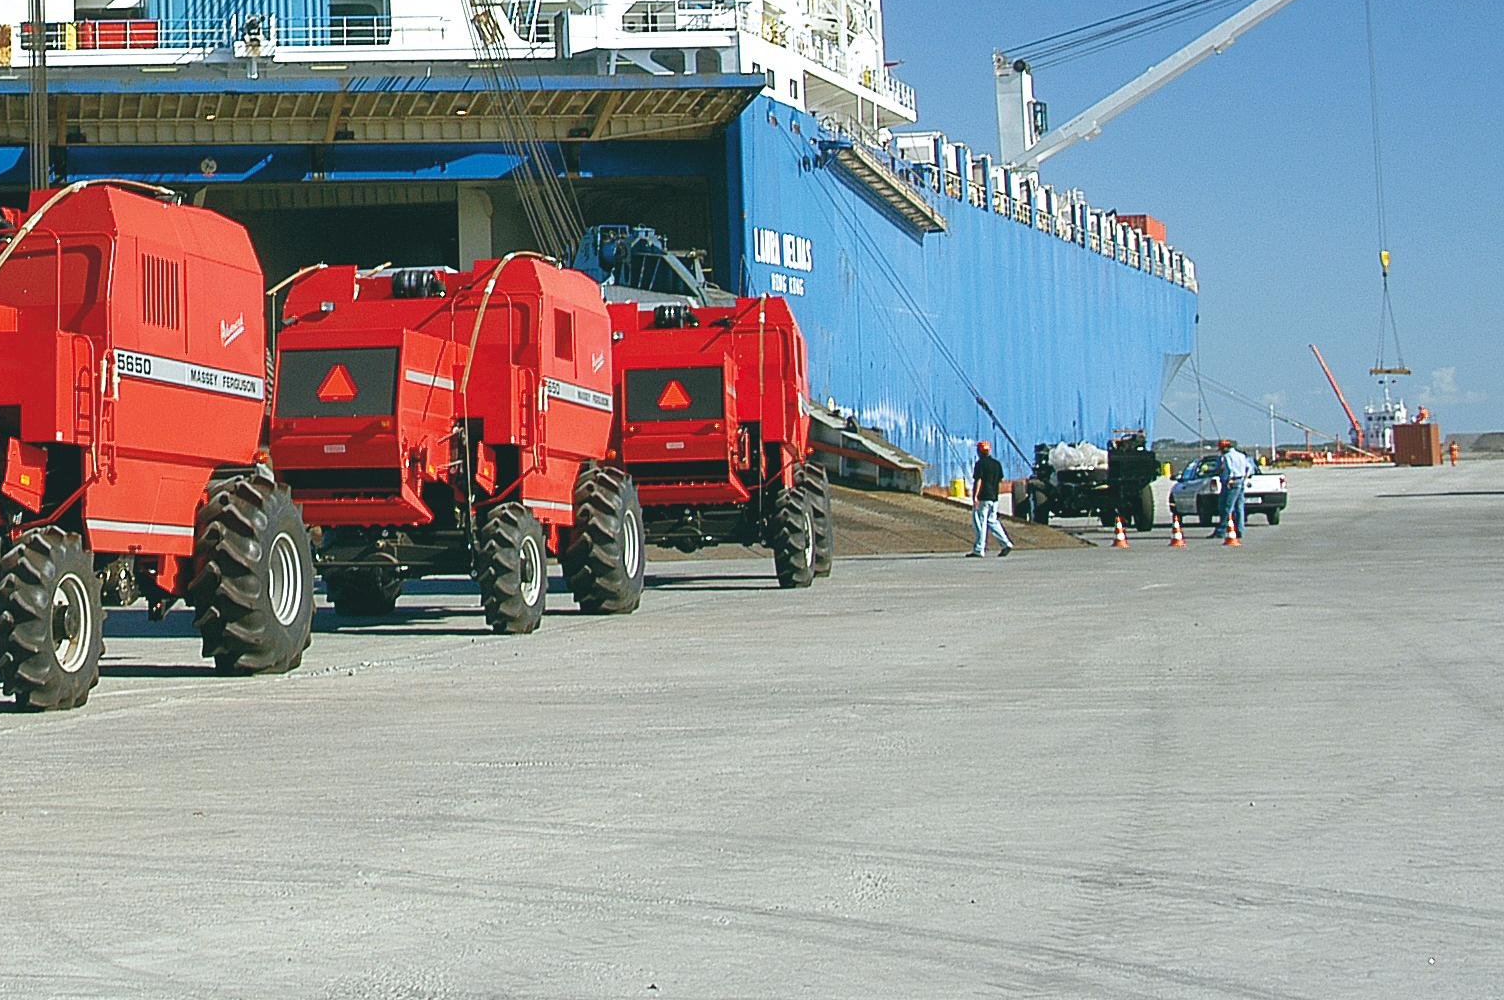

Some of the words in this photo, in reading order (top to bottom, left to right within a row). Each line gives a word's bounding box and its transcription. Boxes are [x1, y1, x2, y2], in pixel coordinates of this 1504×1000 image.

[117, 353, 152, 376] 5650
[190, 368, 218, 387] MASSEY
[222, 375, 256, 394] FERGUSON
